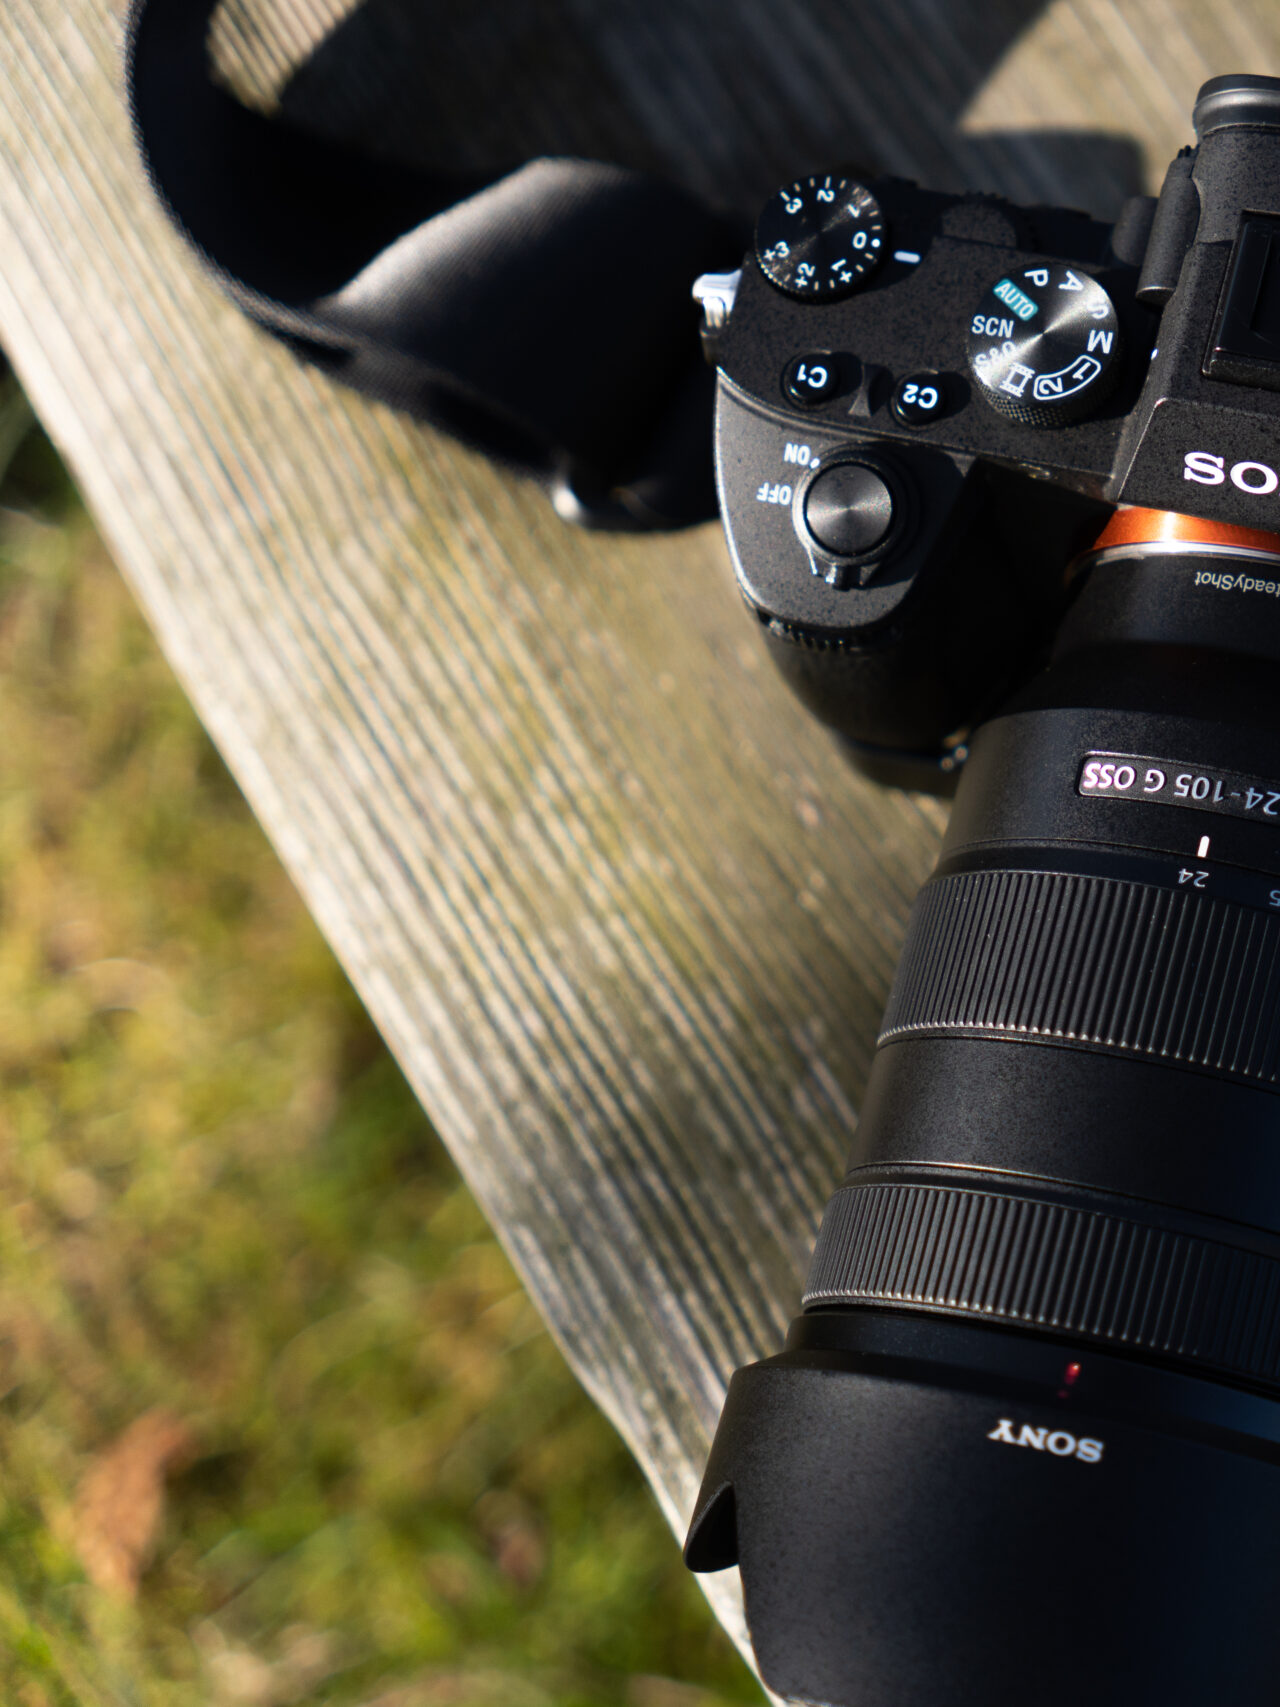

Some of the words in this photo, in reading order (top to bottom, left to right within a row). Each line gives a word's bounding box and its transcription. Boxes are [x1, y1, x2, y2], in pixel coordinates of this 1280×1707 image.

[763, 241, 790, 261] +3
[853, 231, 867, 250] 0
[795, 263, 815, 288] +2
[831, 259, 853, 283] +1
[1024, 269, 1049, 287] P
[1058, 270, 1084, 291] A
[994, 282, 1035, 318] AUTO
[971, 315, 1014, 338] SCN
[1087, 329, 1113, 354] M
[796, 363, 828, 389] C1
[1072, 362, 1091, 380] 1
[902, 383, 939, 409] C2
[1039, 377, 1063, 395] 2
[784, 441, 811, 466] ON
[756, 482, 792, 506] OFF
[1083, 762, 1136, 789] OSS
[1143, 768, 1166, 793] G
[1177, 868, 1209, 888] 24
[986, 1418, 1104, 1464] SONY
